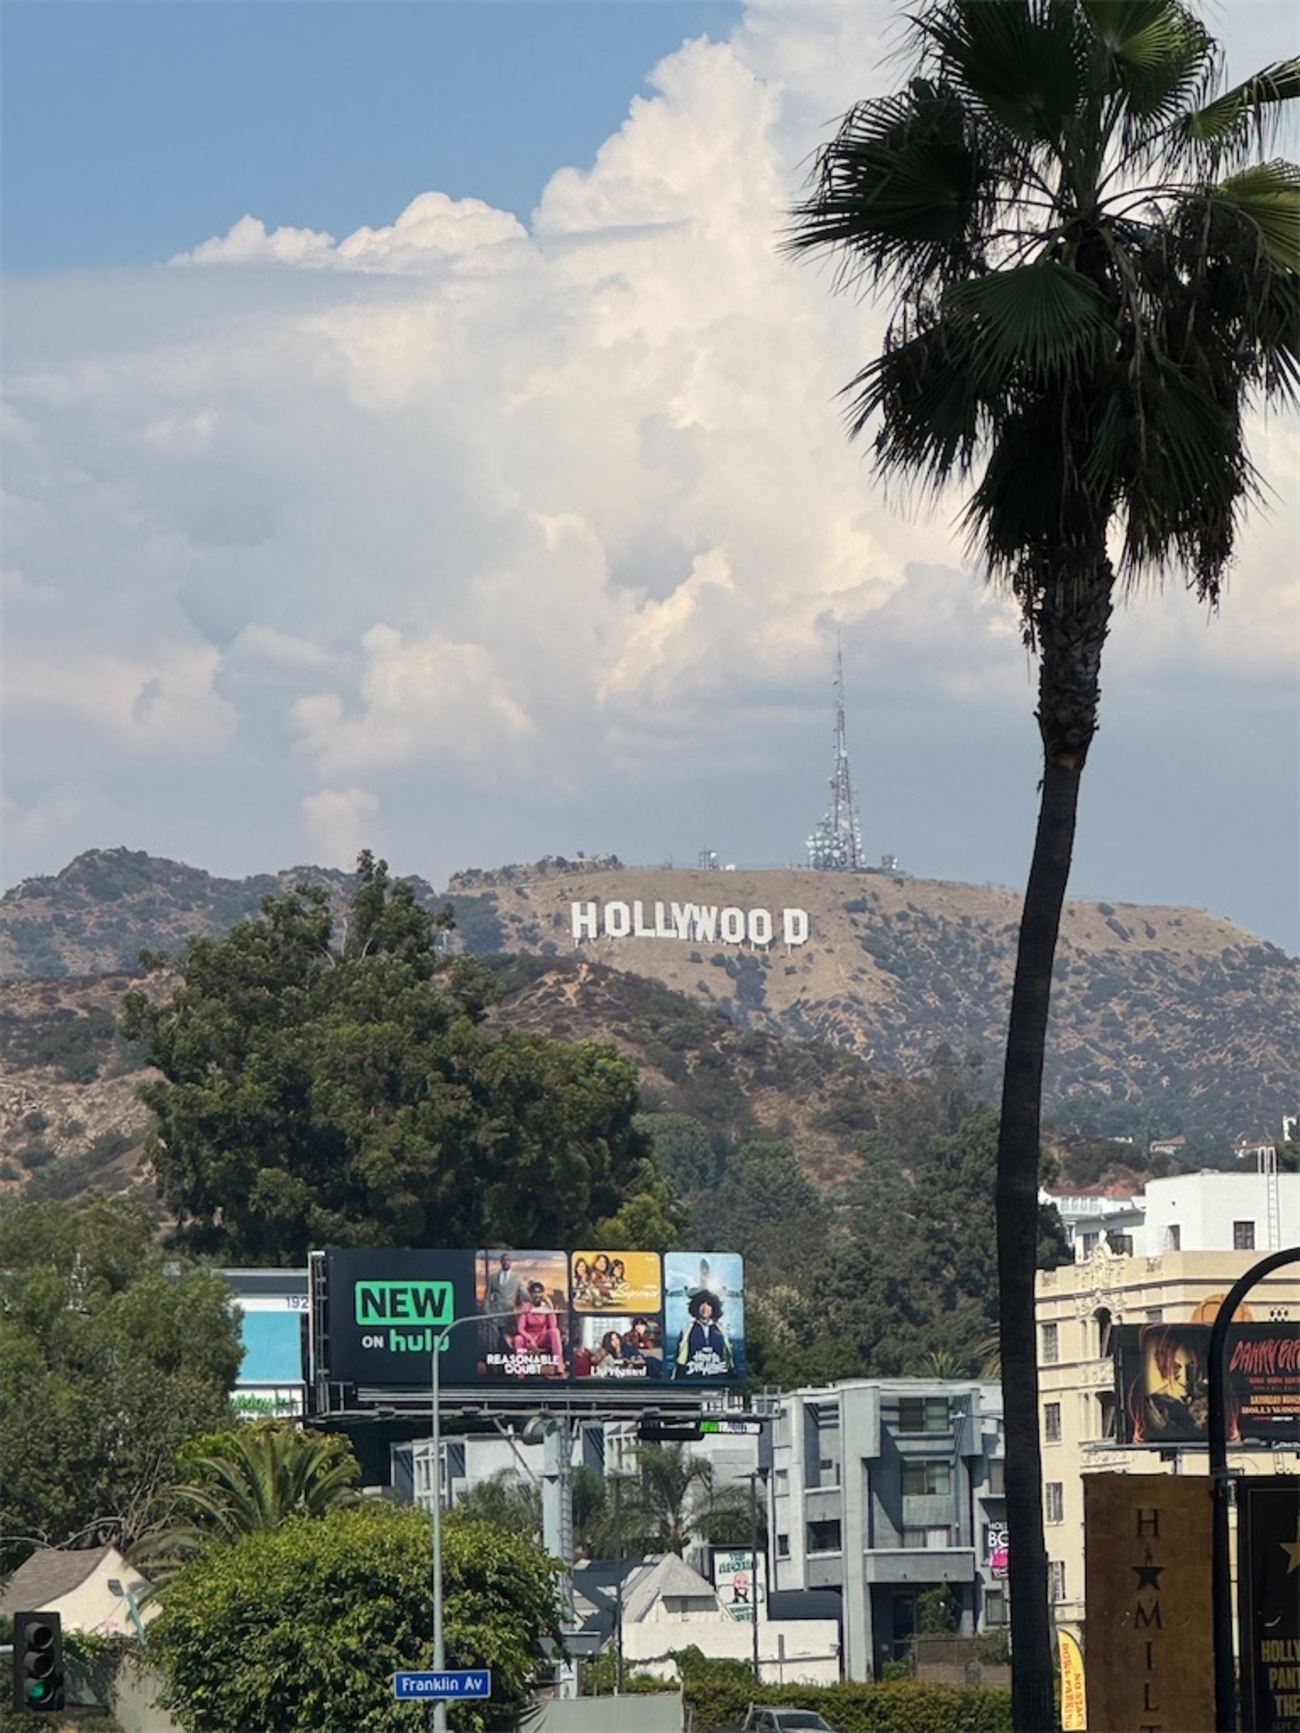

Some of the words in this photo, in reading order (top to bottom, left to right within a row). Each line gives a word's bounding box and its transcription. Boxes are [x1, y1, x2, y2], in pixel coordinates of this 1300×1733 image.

[571, 900, 808, 945] HOLLYWOOD
[361, 1287, 448, 1318] NEW
[362, 1336, 384, 1348] ON
[389, 1329, 450, 1351] hulu
[402, 1676, 459, 1692] Franklin
[464, 1676, 483, 1690] Av
